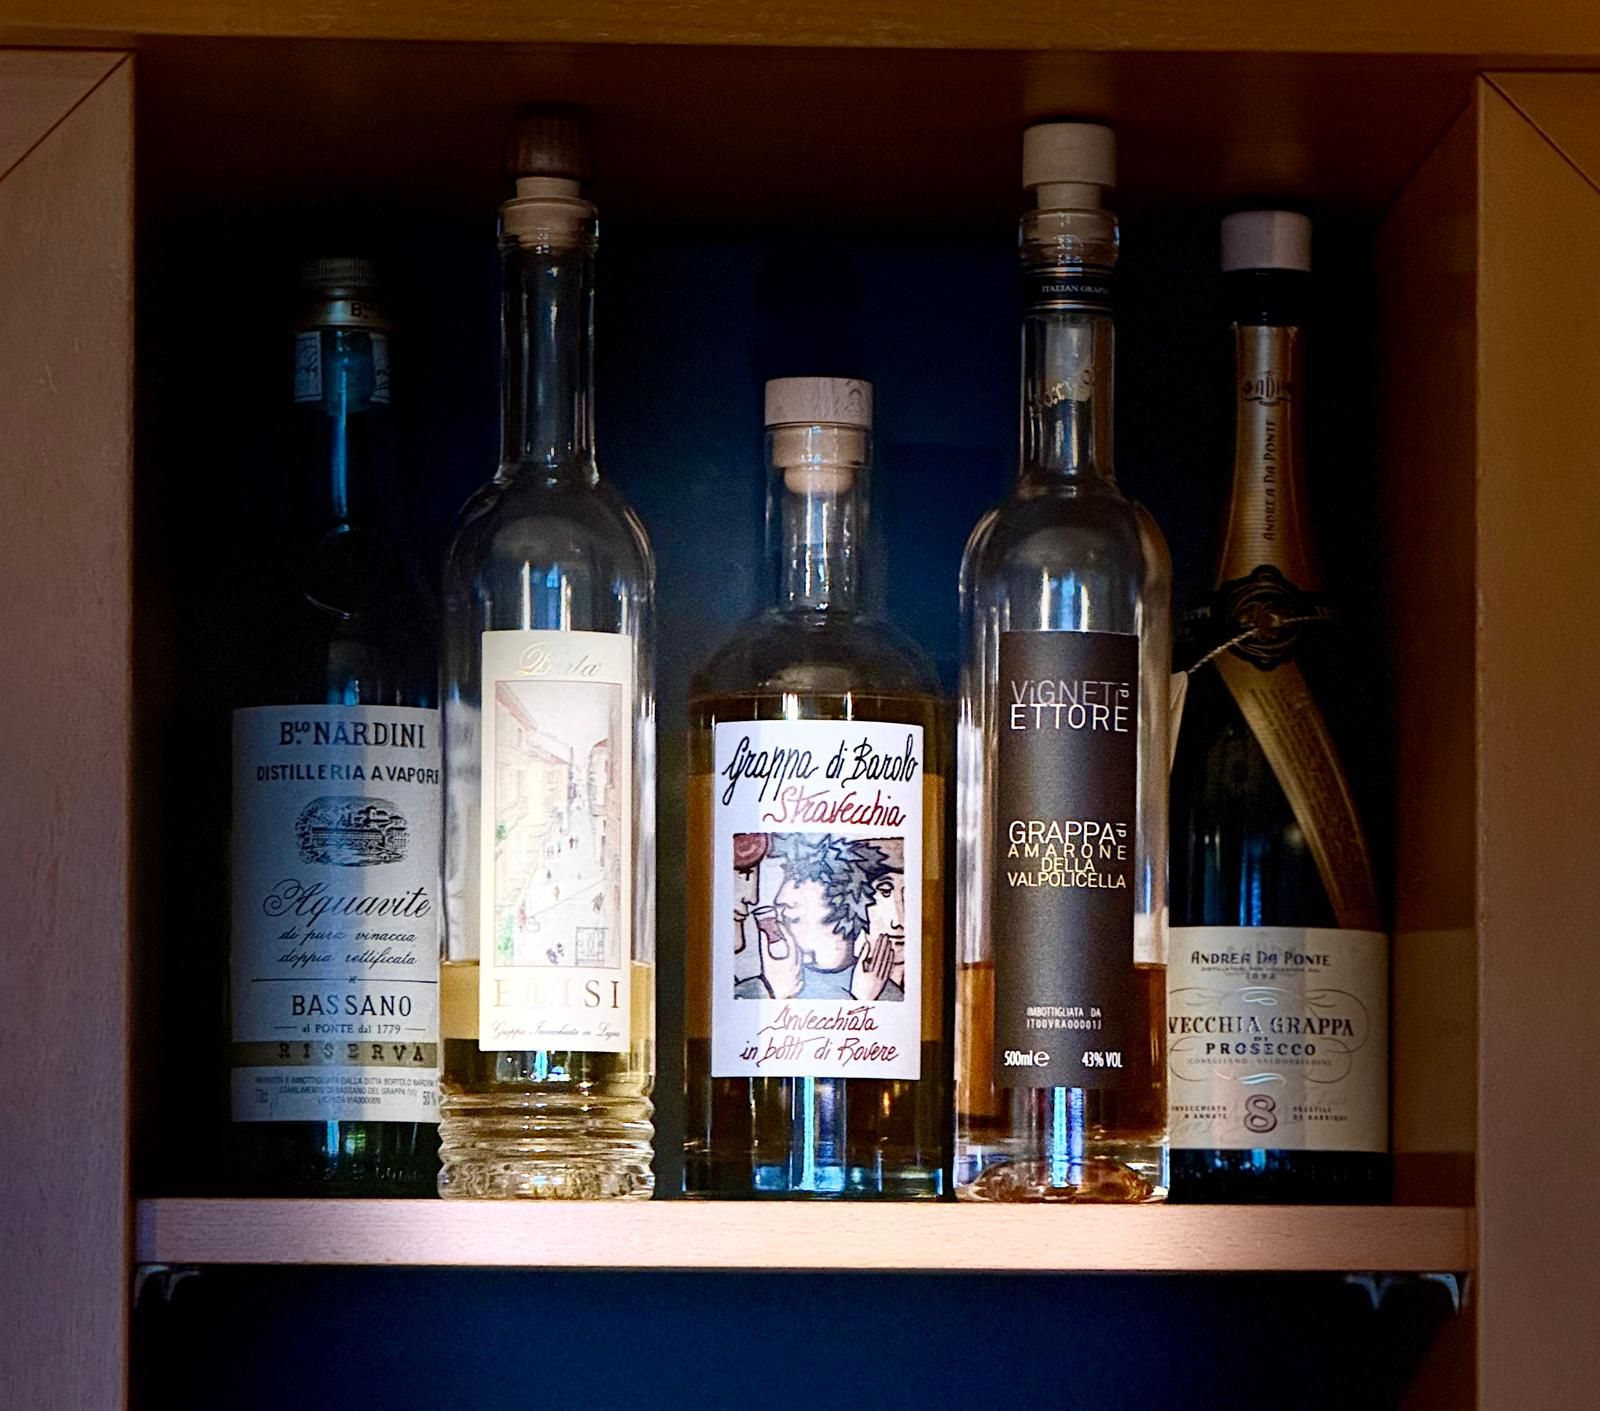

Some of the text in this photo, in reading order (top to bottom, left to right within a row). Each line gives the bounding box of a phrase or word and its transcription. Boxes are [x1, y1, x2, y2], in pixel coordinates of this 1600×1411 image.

[1042, 284, 1078, 293] ITALIAN
[1263, 419, 1277, 461] PONTE
[1263, 465, 1276, 483] DA
[1010, 703, 1129, 733] ETTORE
[313, 721, 425, 749] NARDINI
[256, 764, 365, 781] DISTILLERIA
[371, 766, 383, 781] A
[722, 733, 919, 806] Grappa di Barolo
[762, 785, 907, 827] Stravecchia
[1008, 820, 1117, 846] GRAPPA
[1007, 843, 1127, 861] AMARONE
[1041, 857, 1095, 873] DELLA
[1007, 872, 1127, 889] VALPOLICELLA
[278, 927, 299, 941] di
[355, 931, 417, 942] vinaccia
[277, 949, 334, 968] doppia
[1191, 951, 1250, 966] ANDREA
[1284, 951, 1331, 967] PONTE
[292, 995, 412, 1017] BASSANO
[1090, 1007, 1101, 1018] DA
[315, 1024, 354, 1034] PONTE
[377, 1024, 401, 1035] 1779
[1169, 1016, 1354, 1037] VECCHIA GRAPPA
[277, 1042, 425, 1062] RISERVA
[740, 1040, 759, 1061] in
[813, 1038, 832, 1060] di
[837, 1037, 900, 1067] Rovere
[1206, 1042, 1317, 1056] PROSECCO
[1081, 1051, 1124, 1068] 43% VOL
[1244, 1094, 1277, 1133] 8
